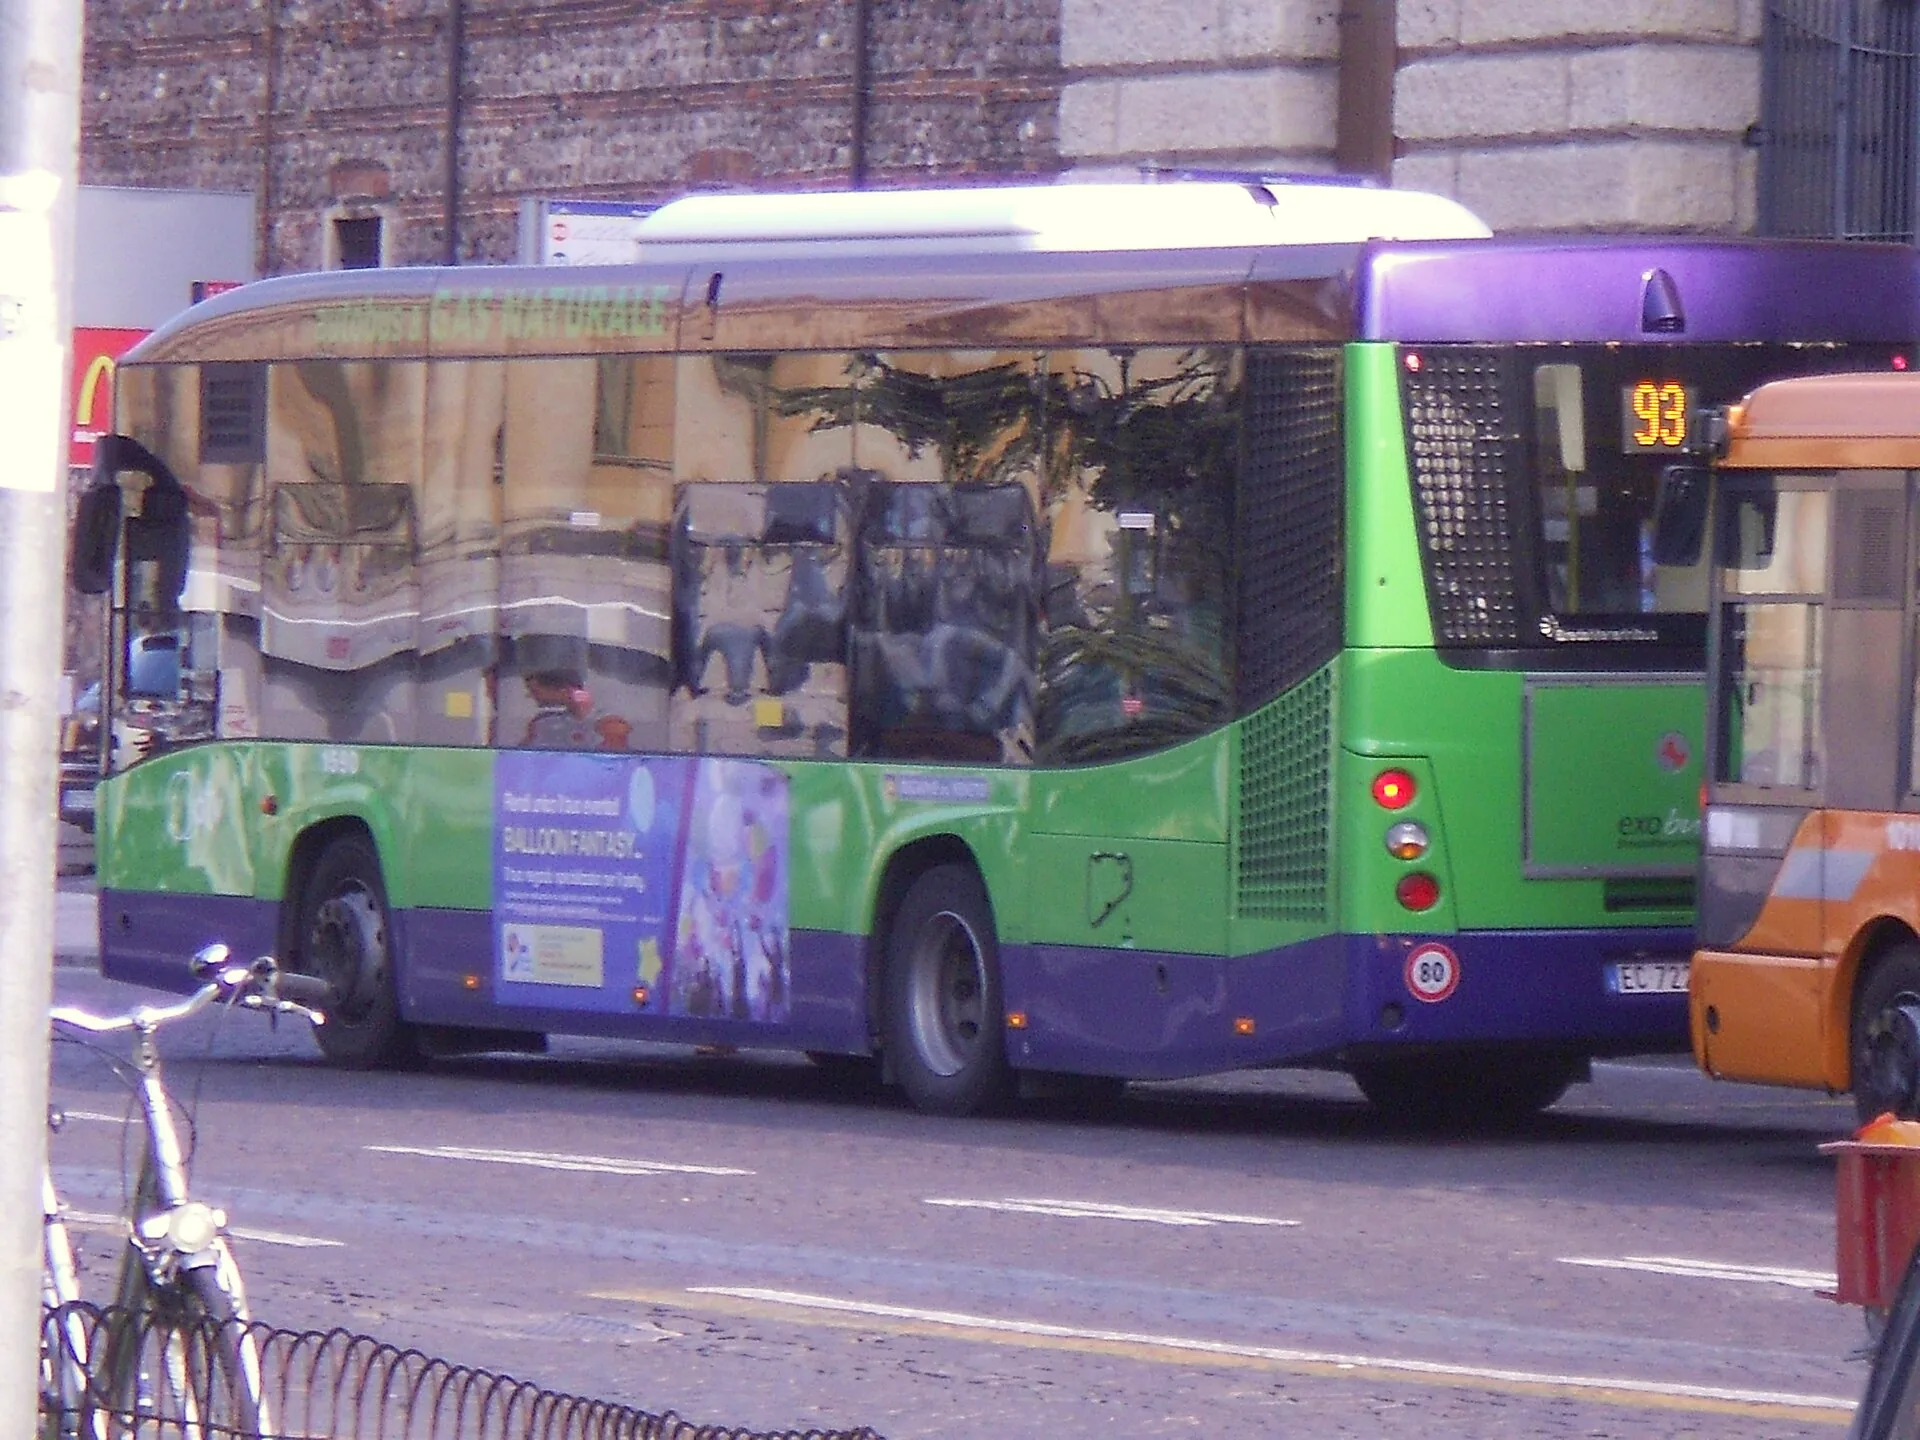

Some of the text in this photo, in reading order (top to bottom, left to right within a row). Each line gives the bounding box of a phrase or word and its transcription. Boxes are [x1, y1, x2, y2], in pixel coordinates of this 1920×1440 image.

[431, 286, 493, 341] GAS
[501, 285, 670, 339] NATURALE
[1633, 381, 1685, 445] 93
[1421, 962, 1444, 983] 80
[1621, 966, 1648, 989] EC
